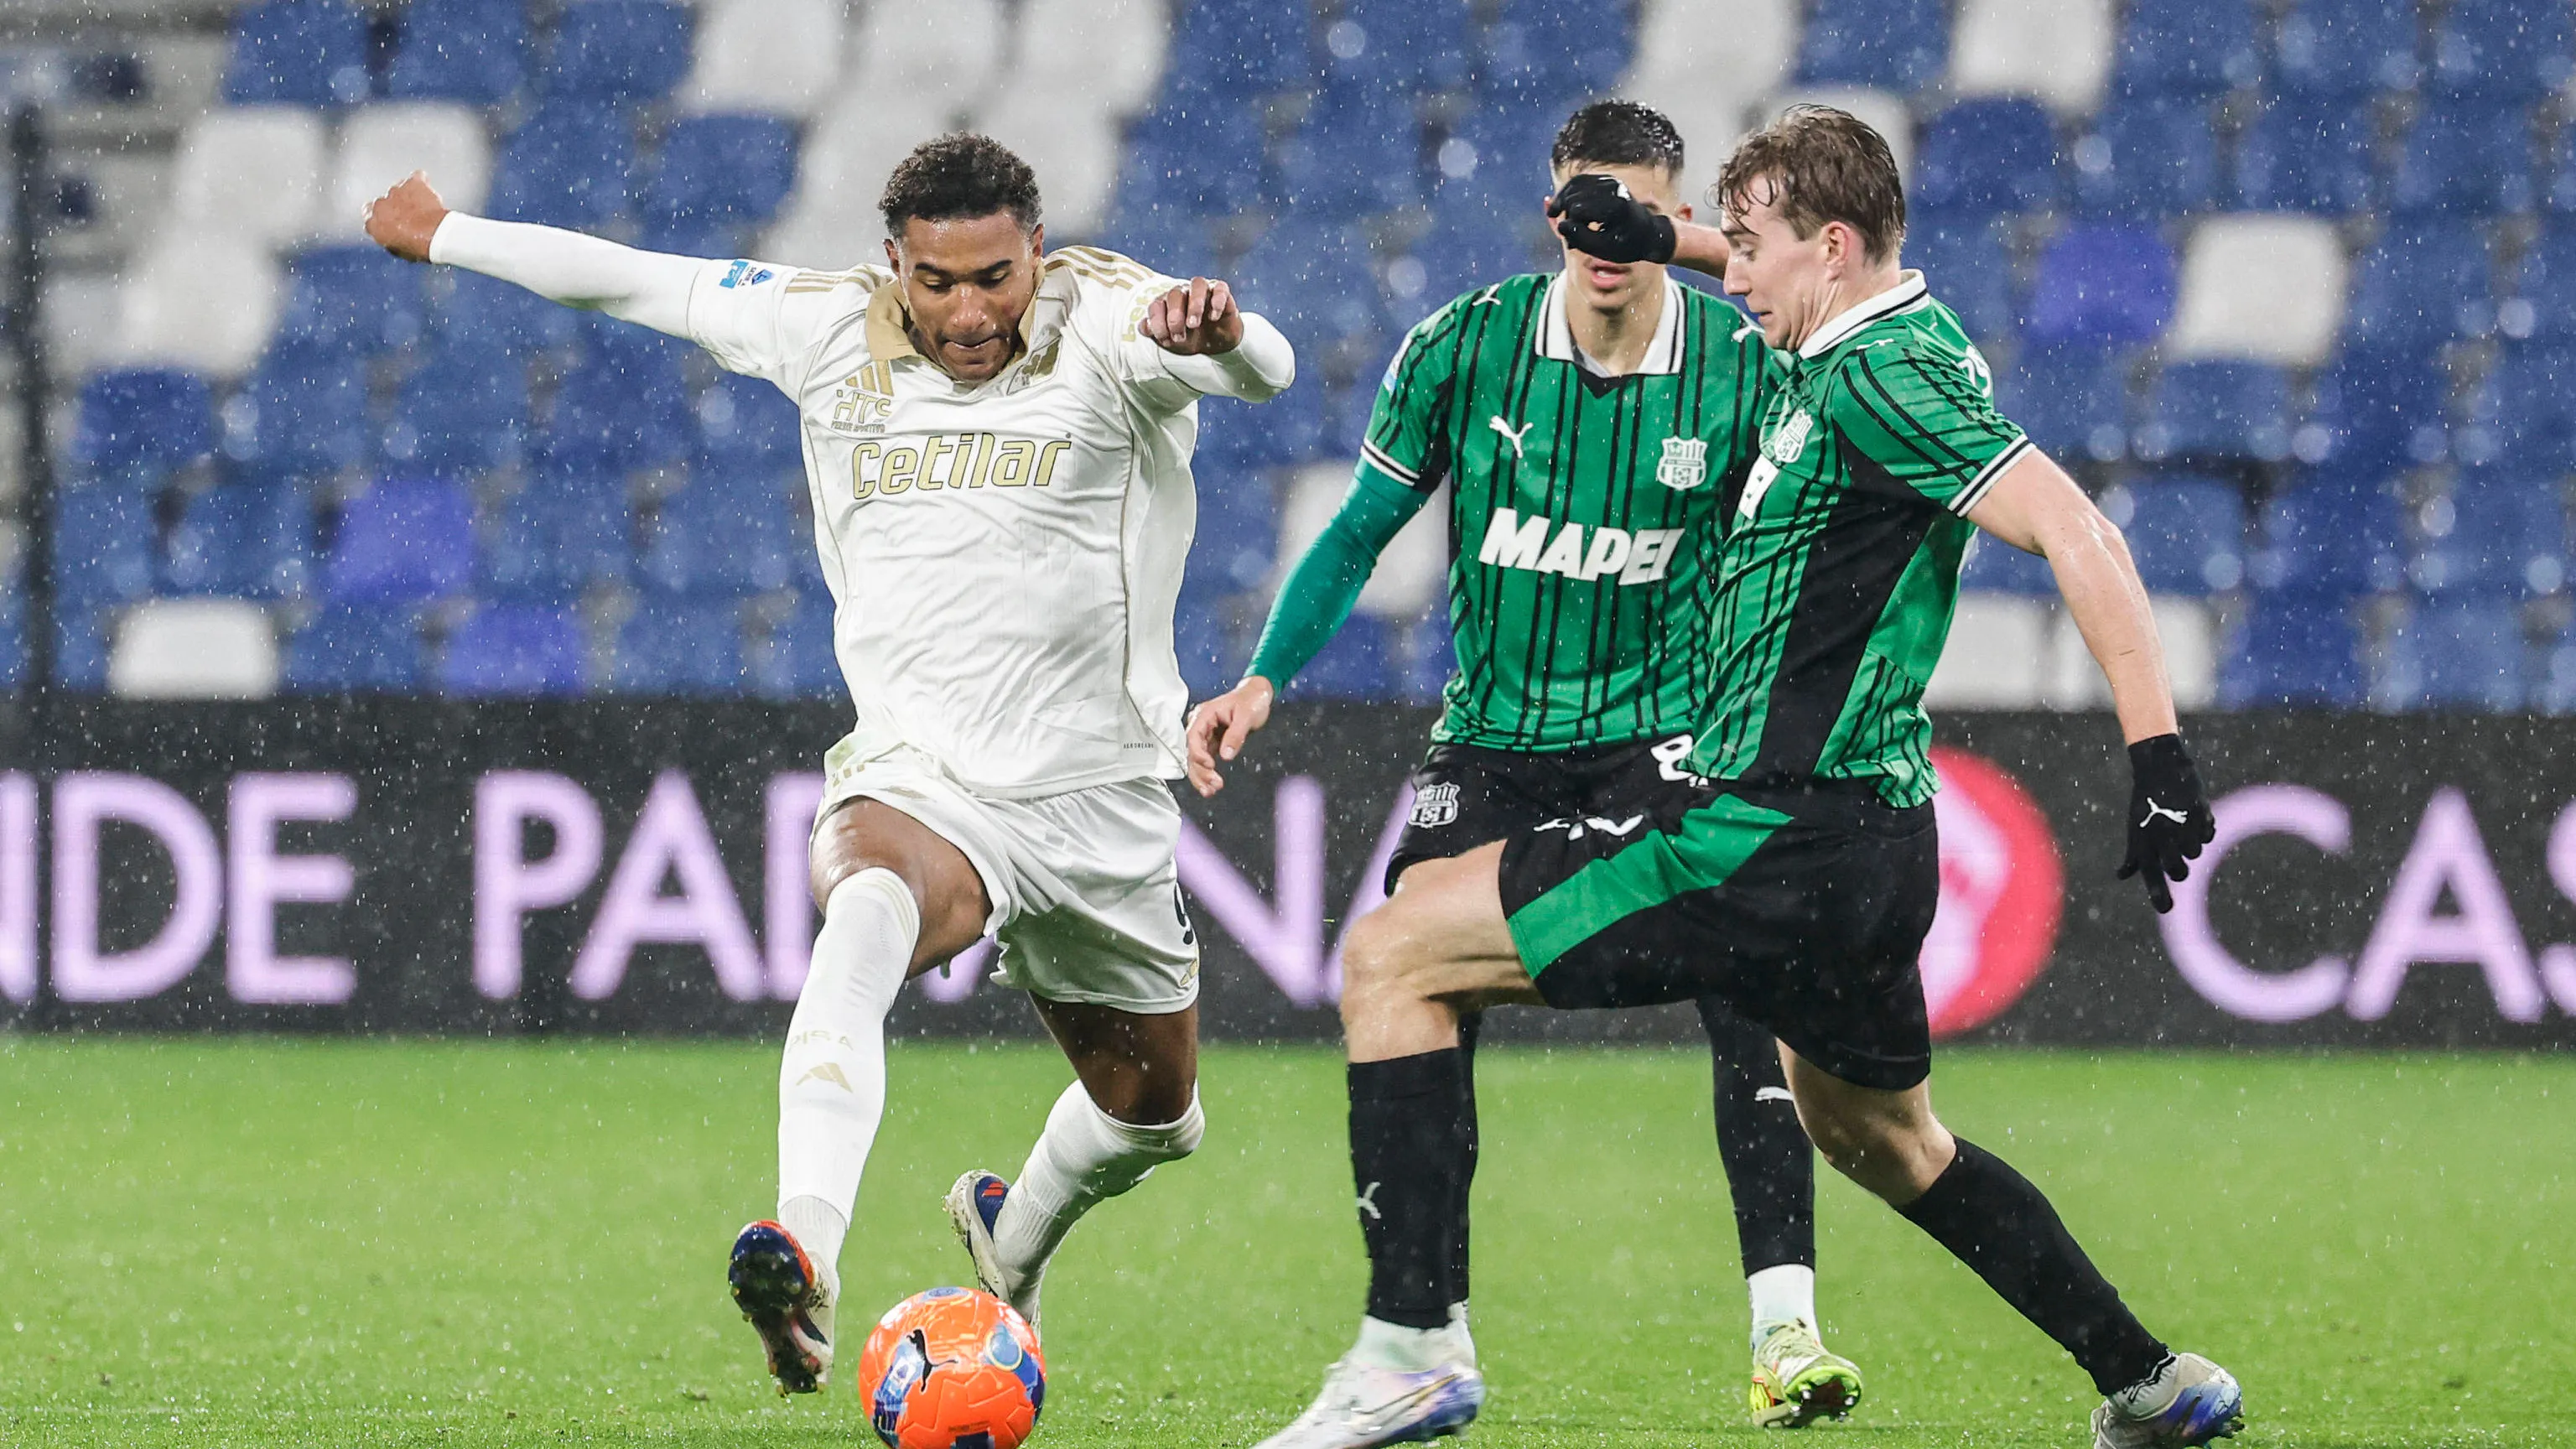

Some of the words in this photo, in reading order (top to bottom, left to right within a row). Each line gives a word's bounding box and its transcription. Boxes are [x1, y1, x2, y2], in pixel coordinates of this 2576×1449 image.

[853, 433, 1072, 500] Cetilar
[1478, 506, 1685, 585] MAPEI
[0, 769, 358, 1003] DE
[2158, 783, 2576, 1024] CA
